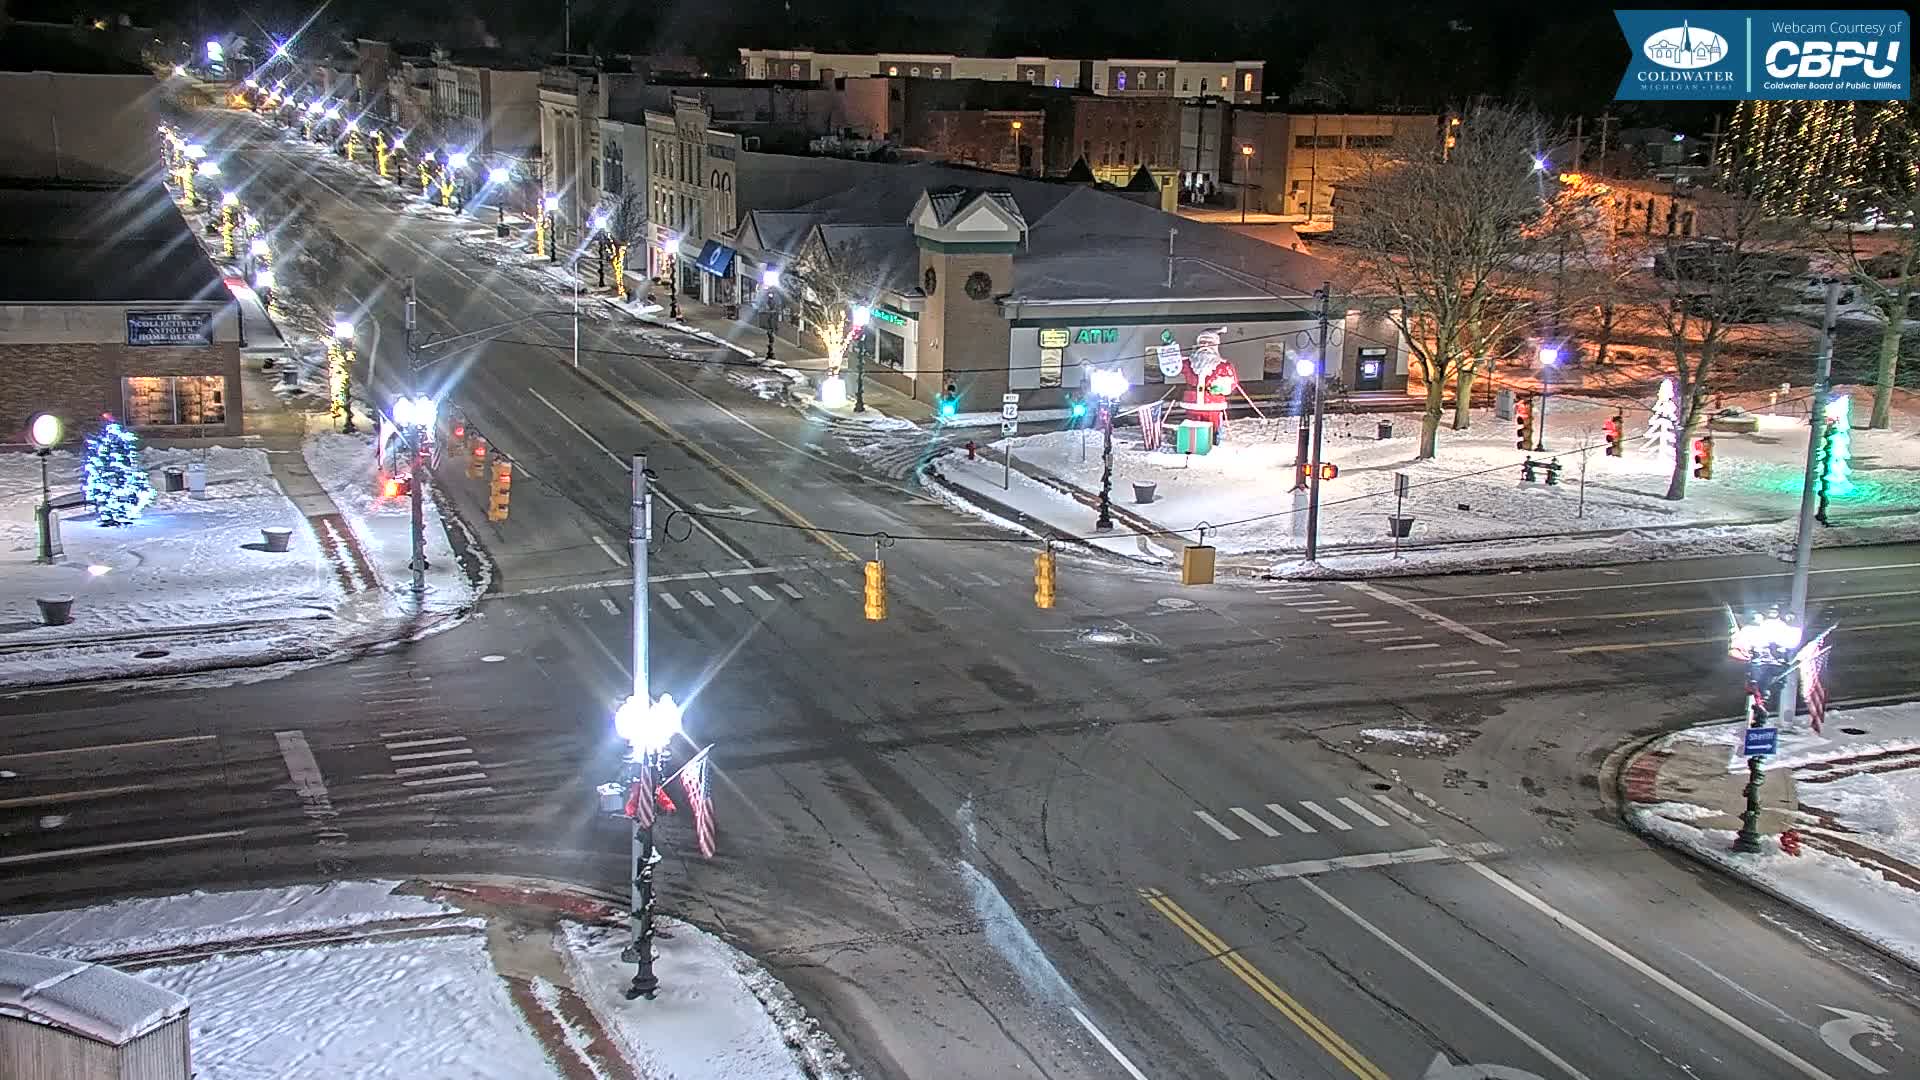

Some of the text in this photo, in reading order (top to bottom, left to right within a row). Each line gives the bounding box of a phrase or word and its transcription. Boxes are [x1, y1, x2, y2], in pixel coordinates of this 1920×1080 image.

[137, 320, 203, 328] COLLECTIBLES
[1075, 328, 1119, 344] ATM
[1005, 406, 1015, 416] 12
